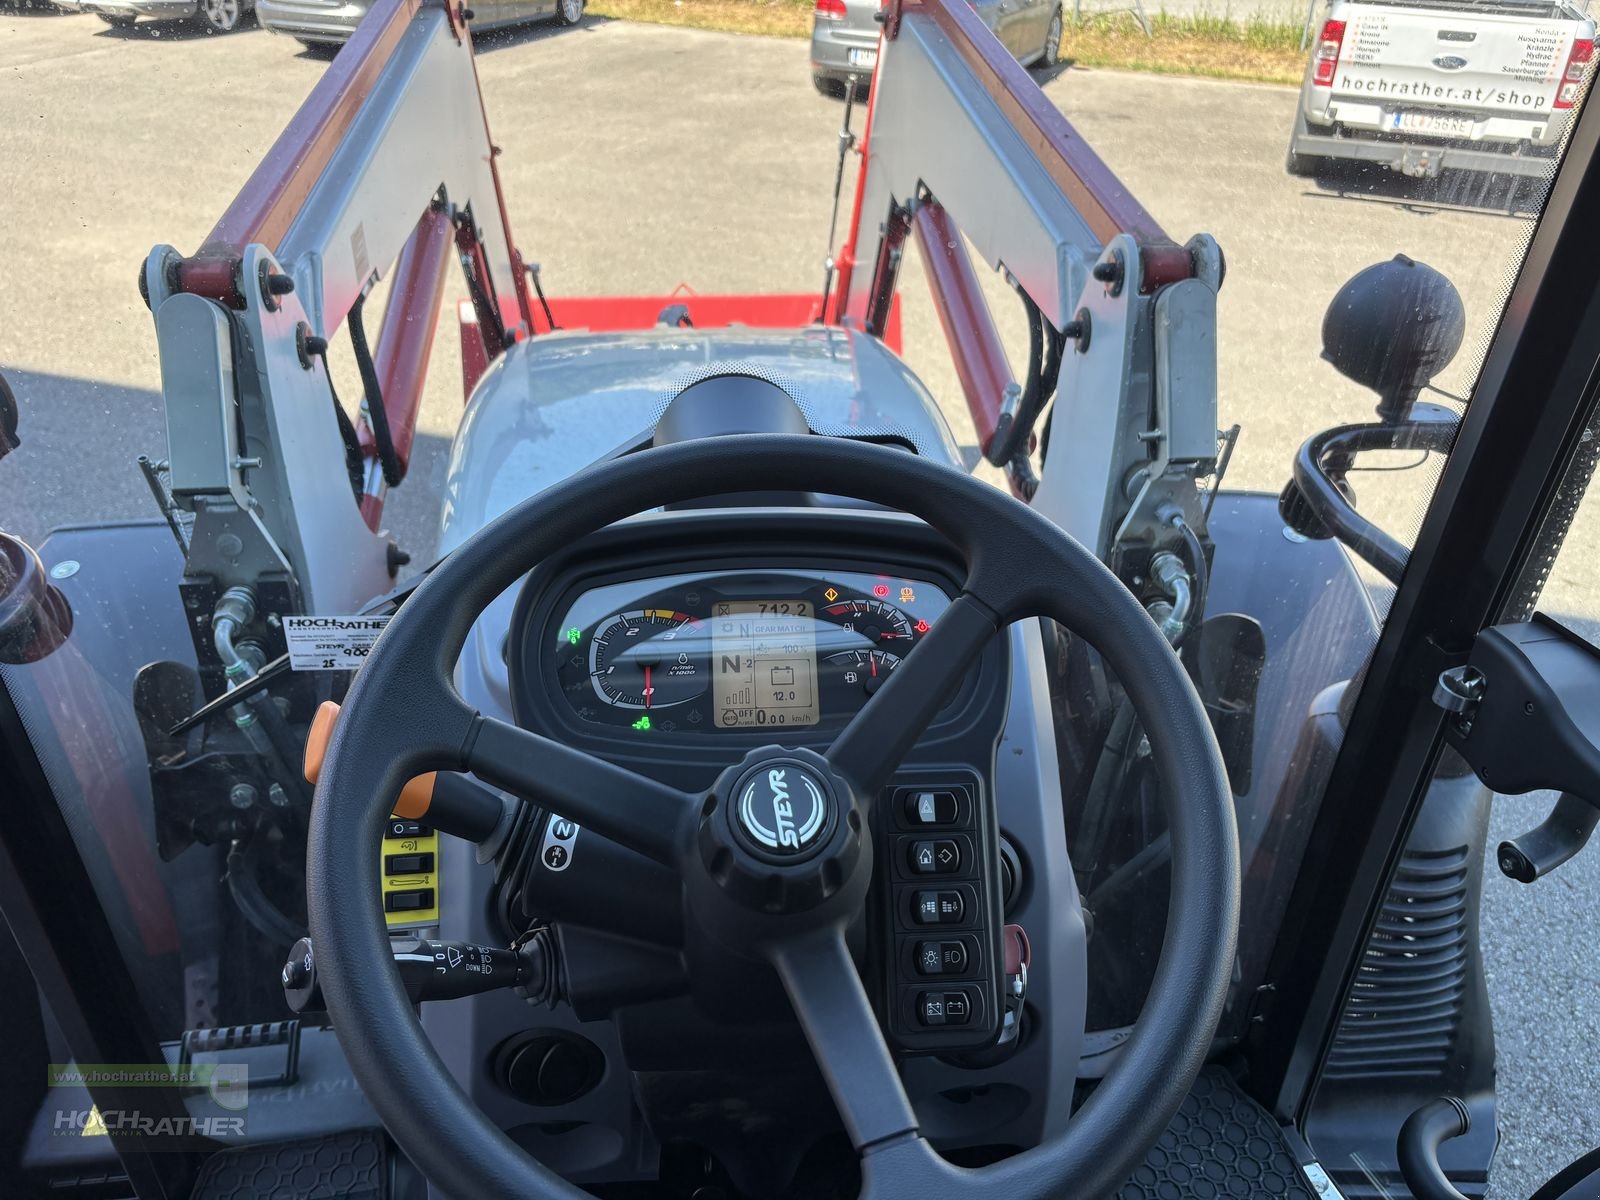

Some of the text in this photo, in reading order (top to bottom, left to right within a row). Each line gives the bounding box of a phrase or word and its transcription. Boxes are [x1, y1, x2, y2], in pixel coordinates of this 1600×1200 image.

[1518, 35, 1557, 44] Husqvarna
[1342, 76, 1545, 108] hochrather.at/shop
[758, 603, 806, 616] 712.2
[626, 628, 640, 636] 2
[664, 632, 677, 640] 3
[740, 624, 749, 638] N
[322, 659, 337, 668] 25
[721, 655, 741, 674] N
[606, 666, 615, 674] 1
[773, 691, 795, 701] 12.0
[738, 710, 753, 718] OFF
[757, 709, 785, 725] 0.00
[768, 769, 800, 850] STEYR
[556, 821, 571, 837] N
[465, 963, 481, 972] DOWN
